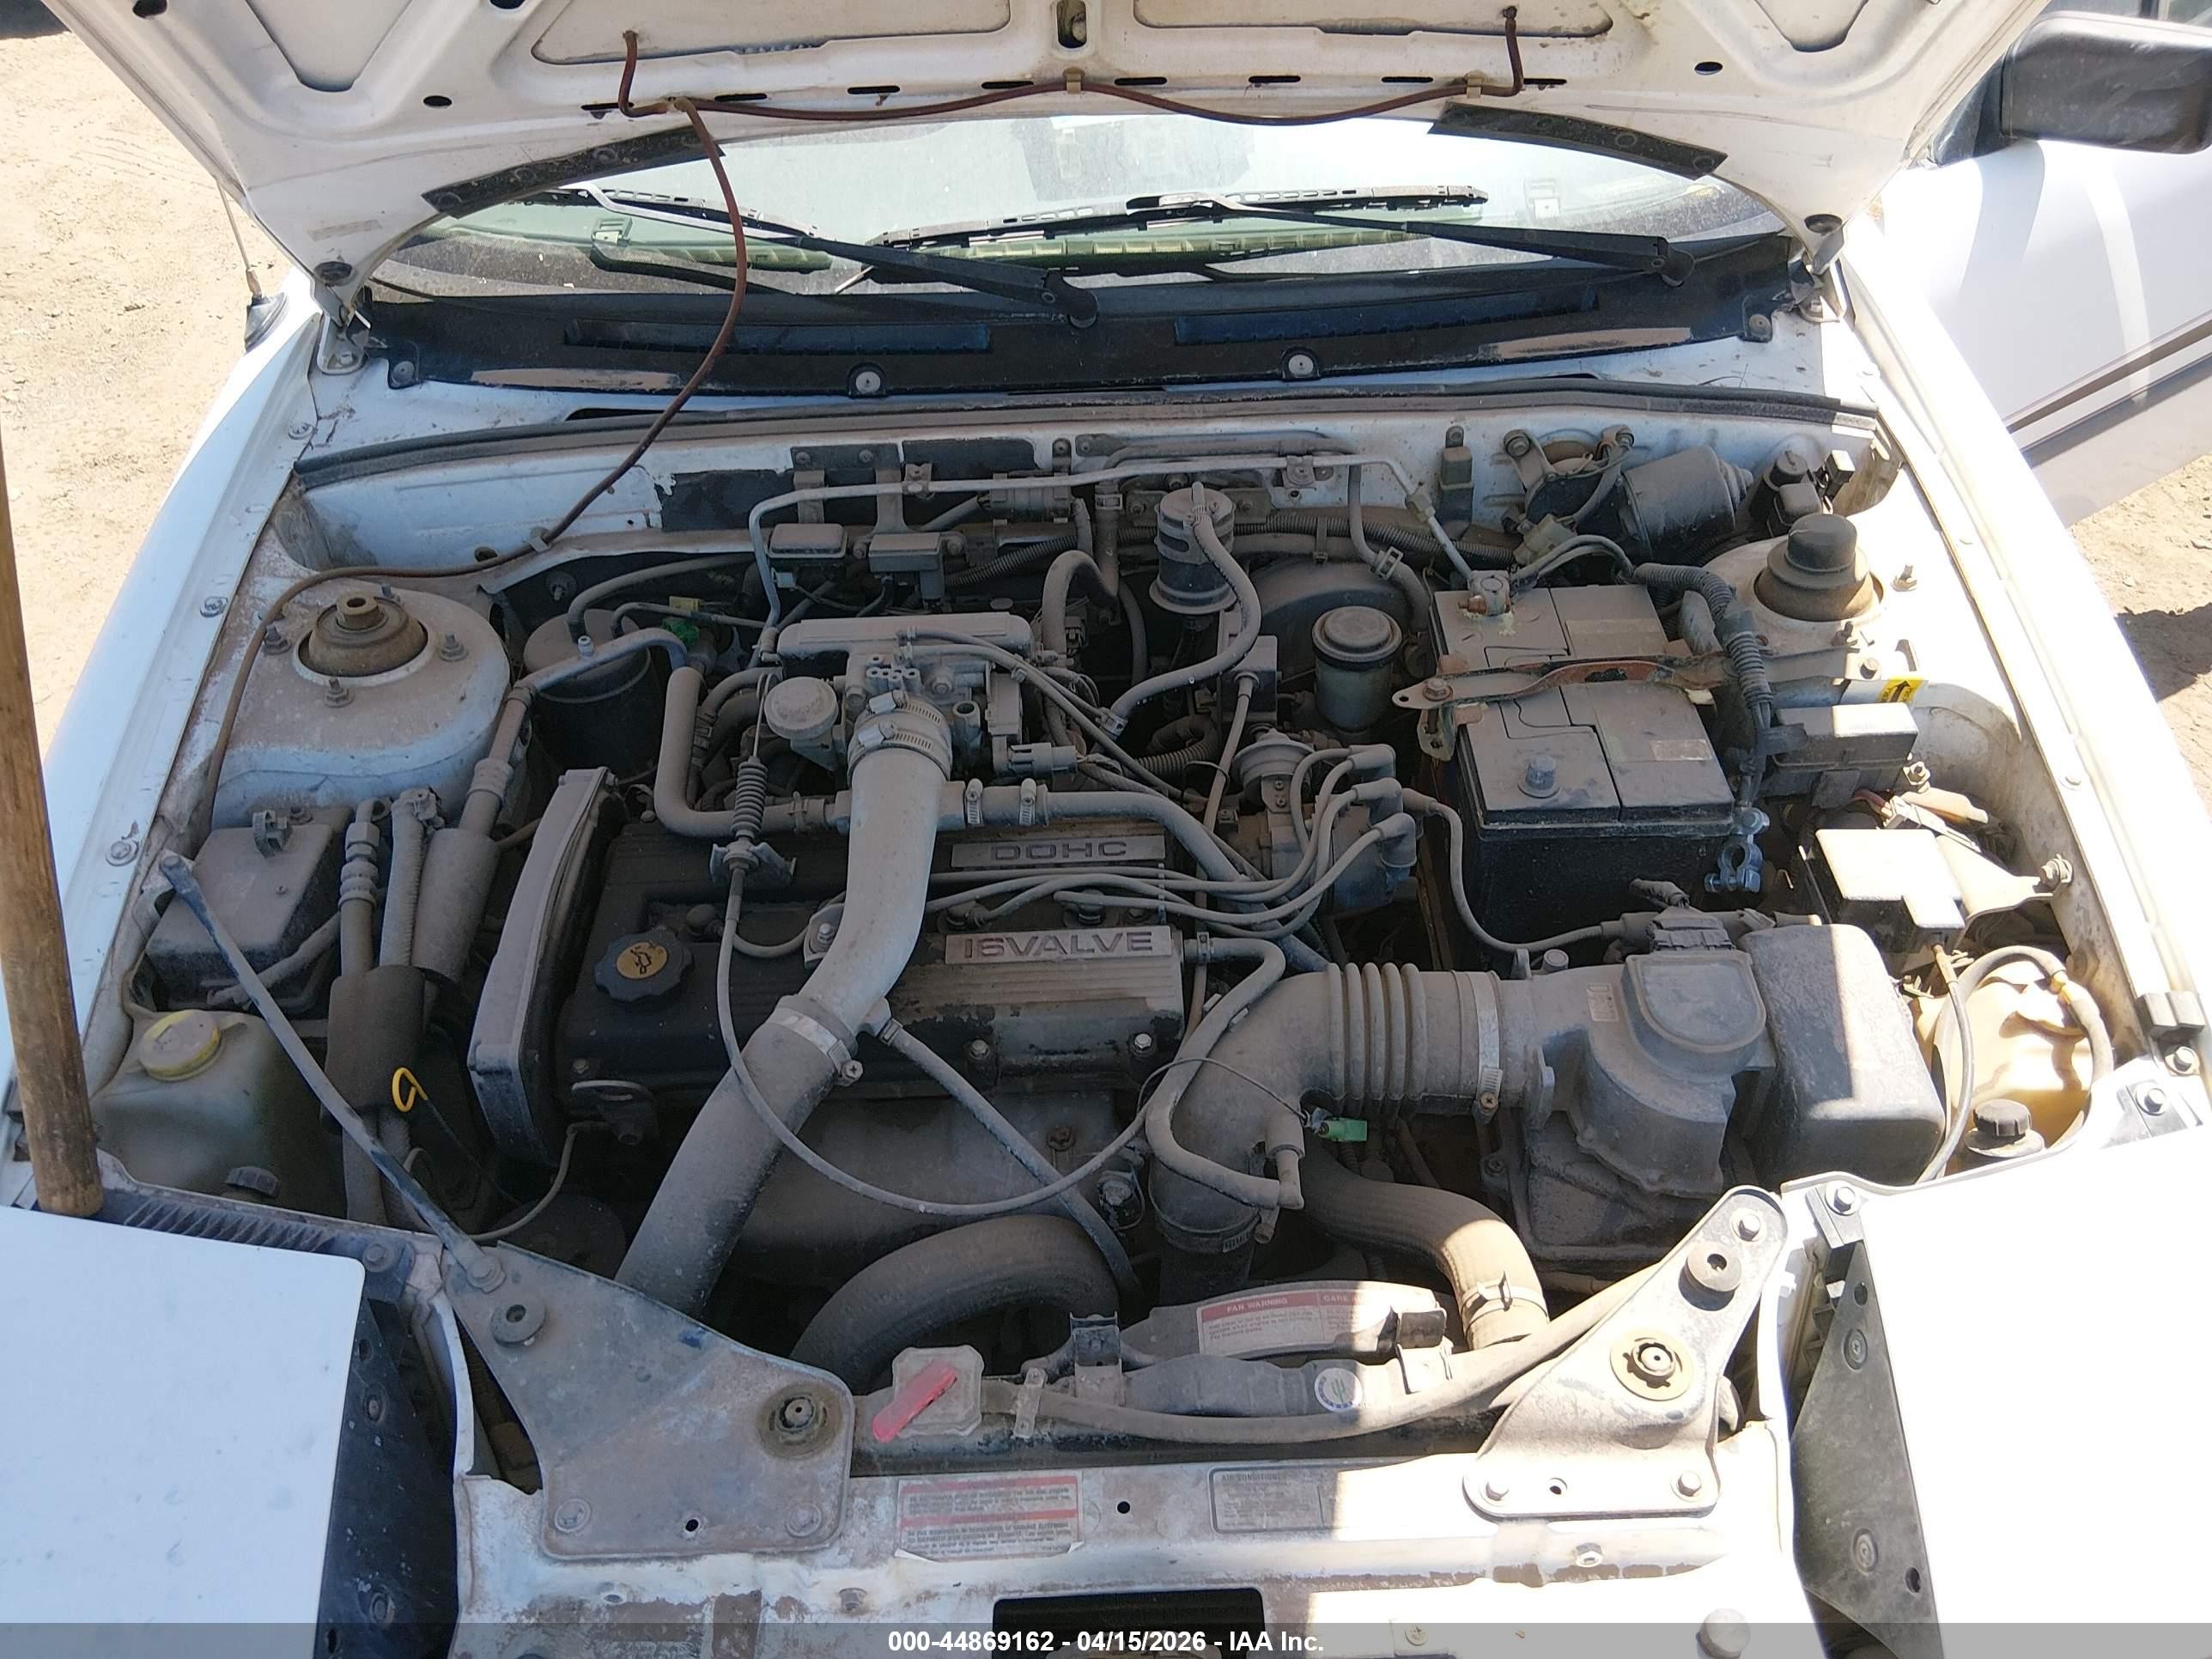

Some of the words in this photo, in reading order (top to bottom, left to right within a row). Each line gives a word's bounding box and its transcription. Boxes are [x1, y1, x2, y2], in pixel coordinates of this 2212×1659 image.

[990, 841, 1127, 861] DOHC
[1226, 1304, 1245, 1313] FAN
[1247, 1297, 1288, 1310] WARNING
